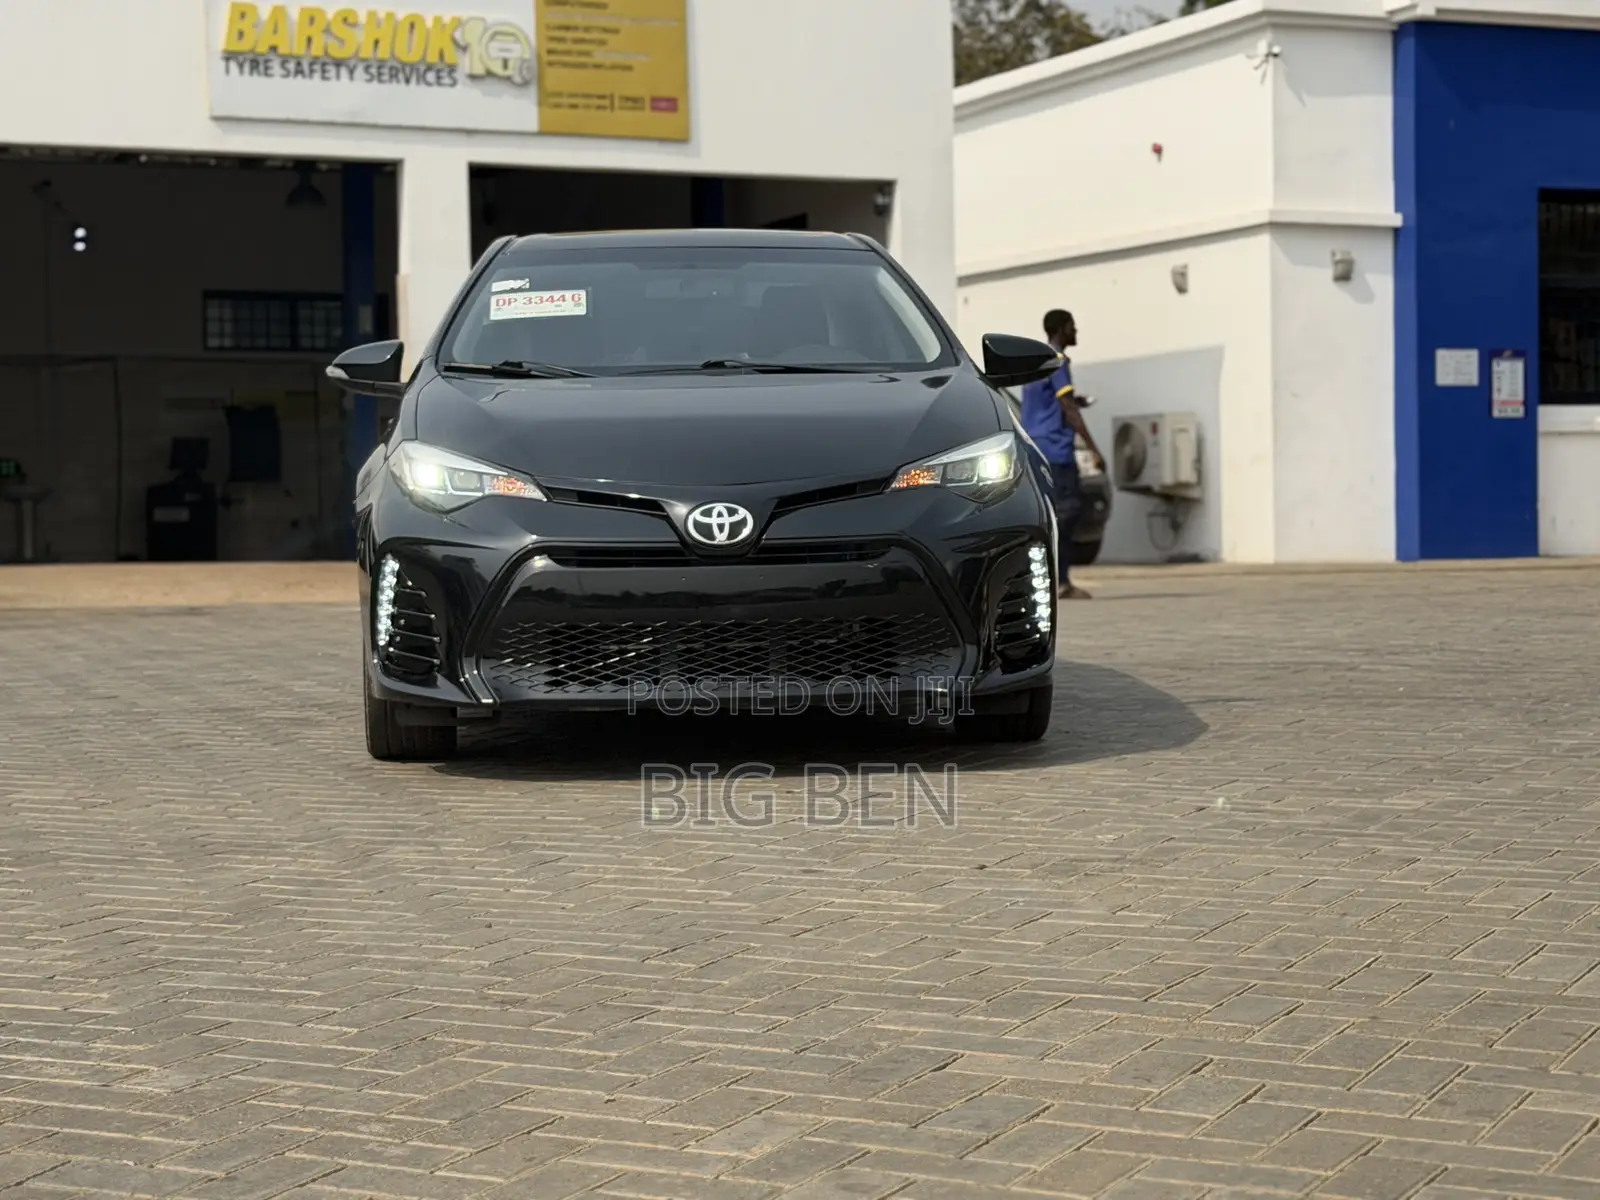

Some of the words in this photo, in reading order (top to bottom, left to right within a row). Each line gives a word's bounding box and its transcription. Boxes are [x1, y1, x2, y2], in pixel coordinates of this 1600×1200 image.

[223, 2, 462, 65] BARSHOK
[222, 56, 275, 78] TYRE
[279, 59, 359, 83] SAFETY
[362, 64, 459, 88] SERVICES
[495, 297, 518, 307] DP
[522, 294, 567, 305] 3344
